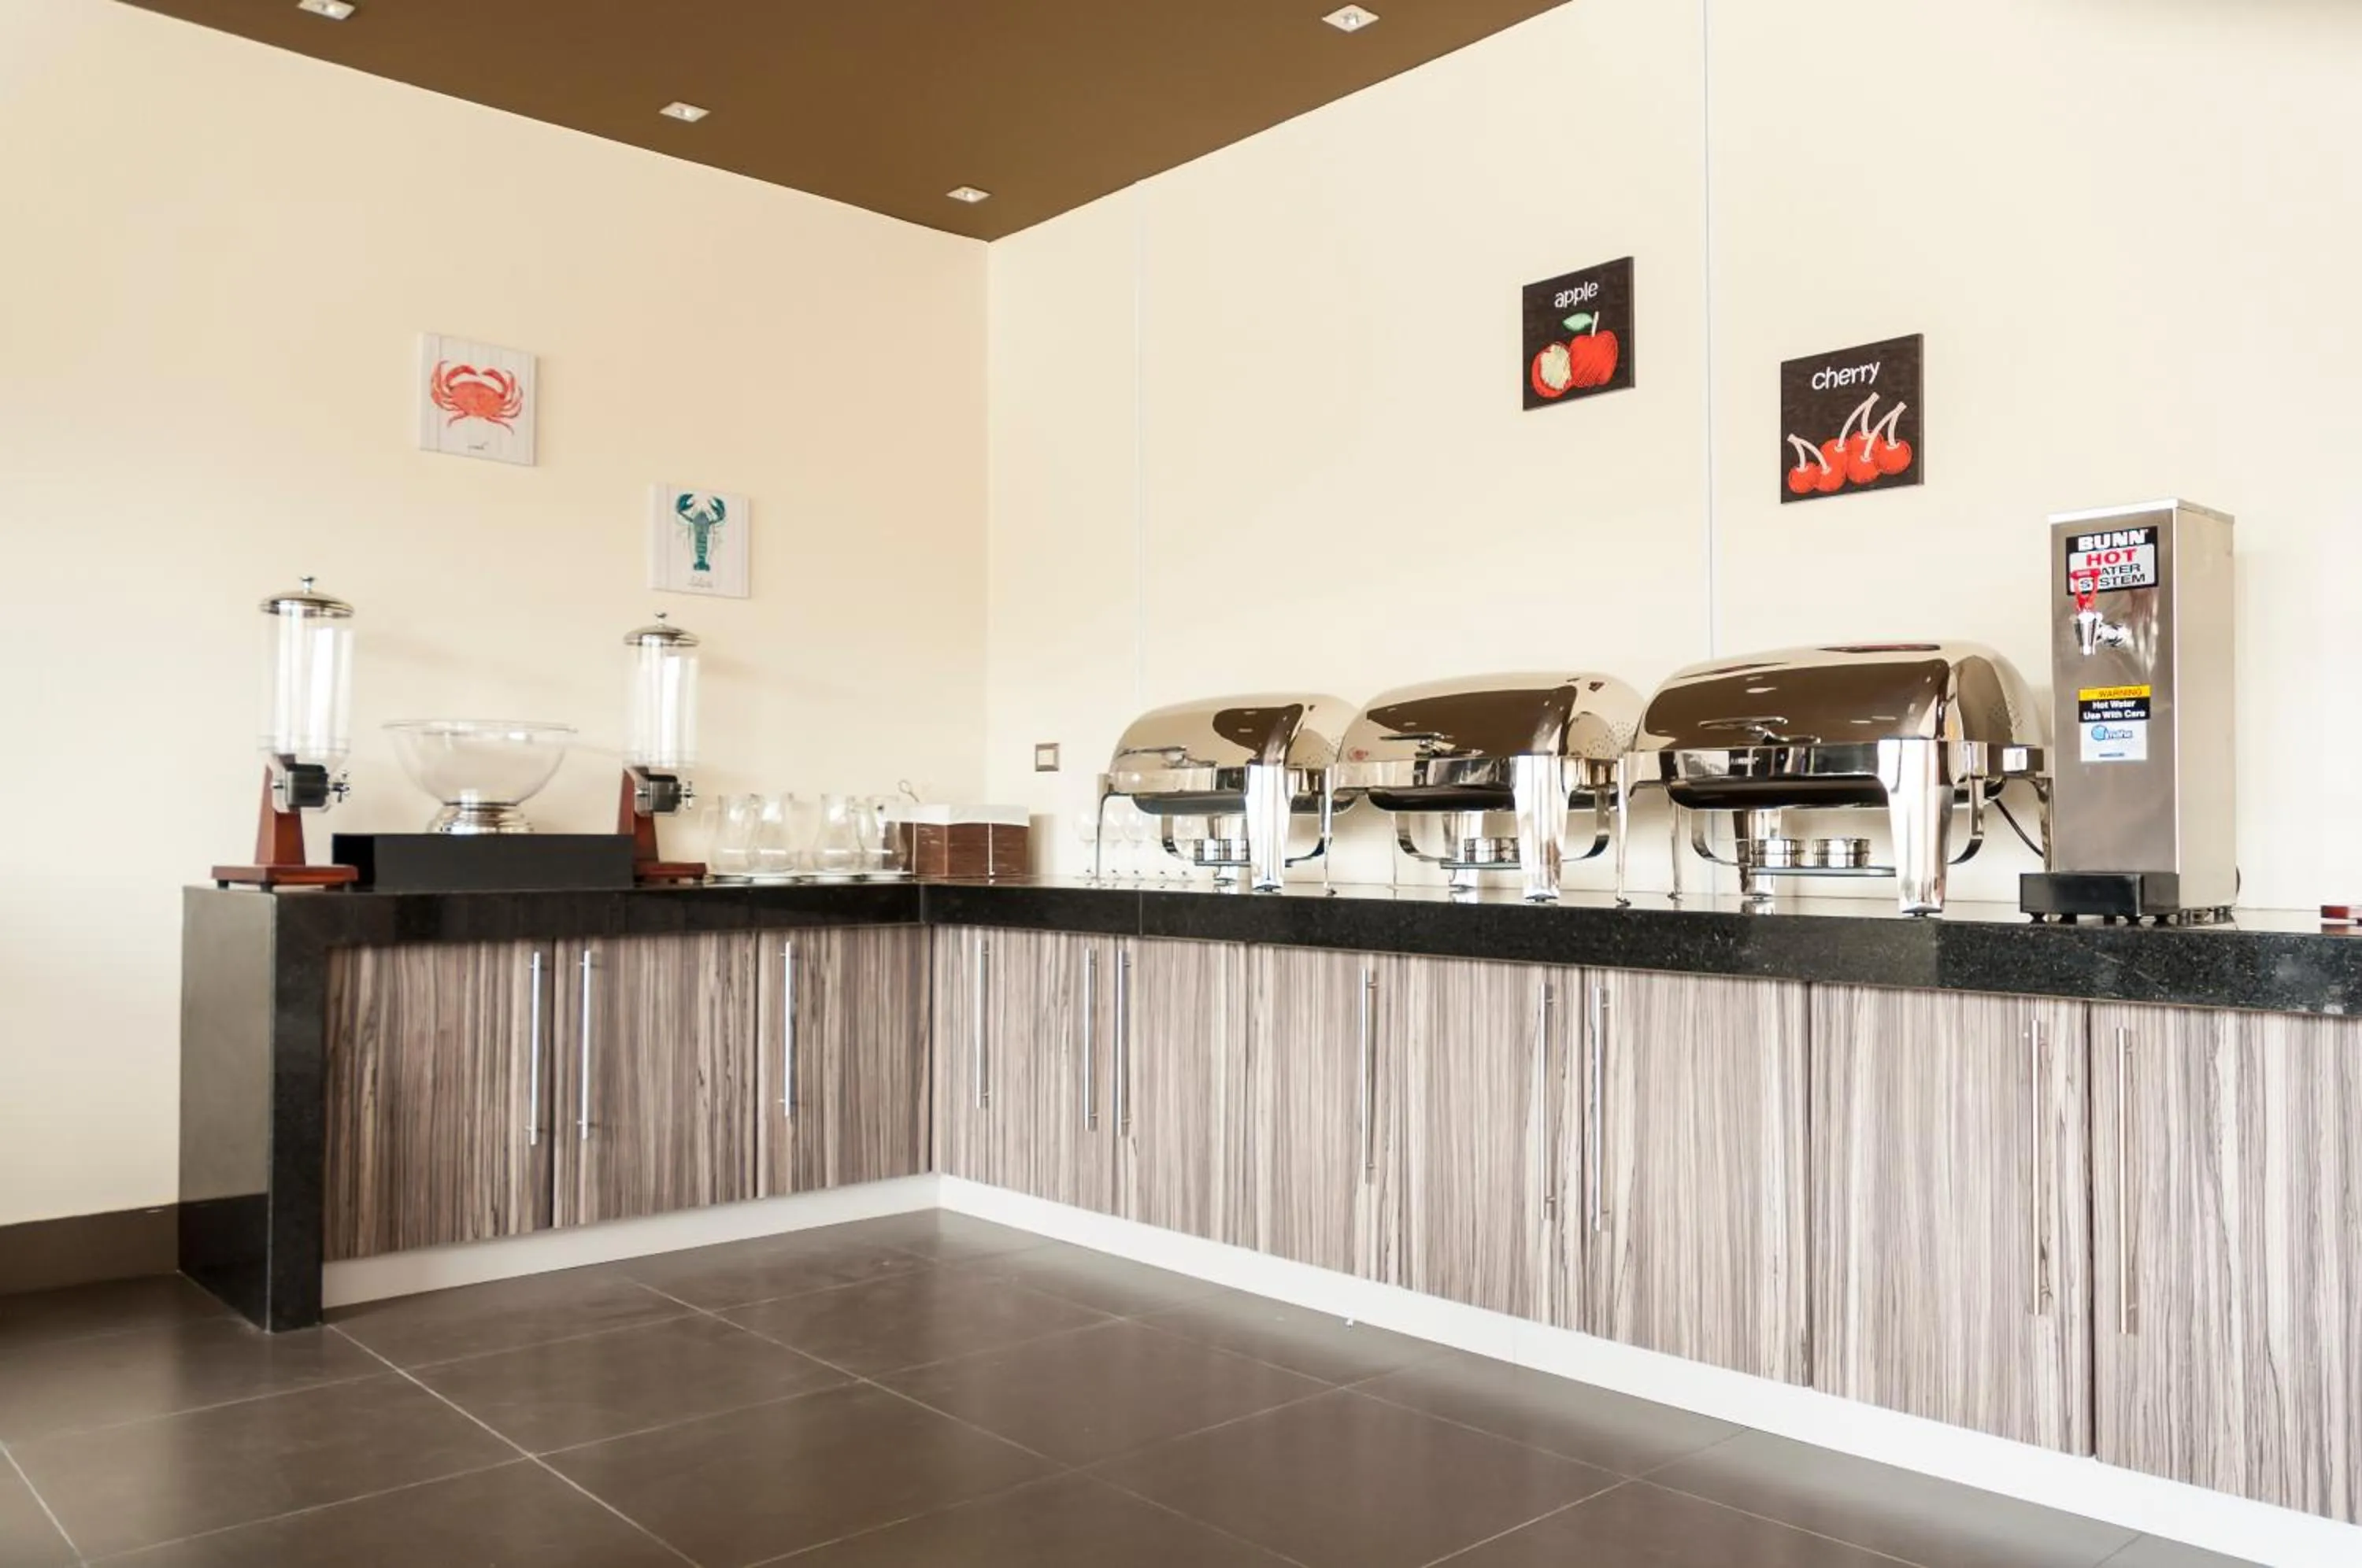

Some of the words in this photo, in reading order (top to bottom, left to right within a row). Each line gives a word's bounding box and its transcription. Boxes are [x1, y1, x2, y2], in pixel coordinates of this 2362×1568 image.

[1555, 281, 1598, 309] apple
[1812, 361, 1881, 390] cherry
[2078, 529, 2145, 551] BUNN
[2086, 549, 2136, 566] HOT
[2080, 574, 2145, 589] SSTEM
[2098, 687, 2142, 698] WARNING
[2083, 712, 2101, 720] Use
[2124, 709, 2145, 718] Care
